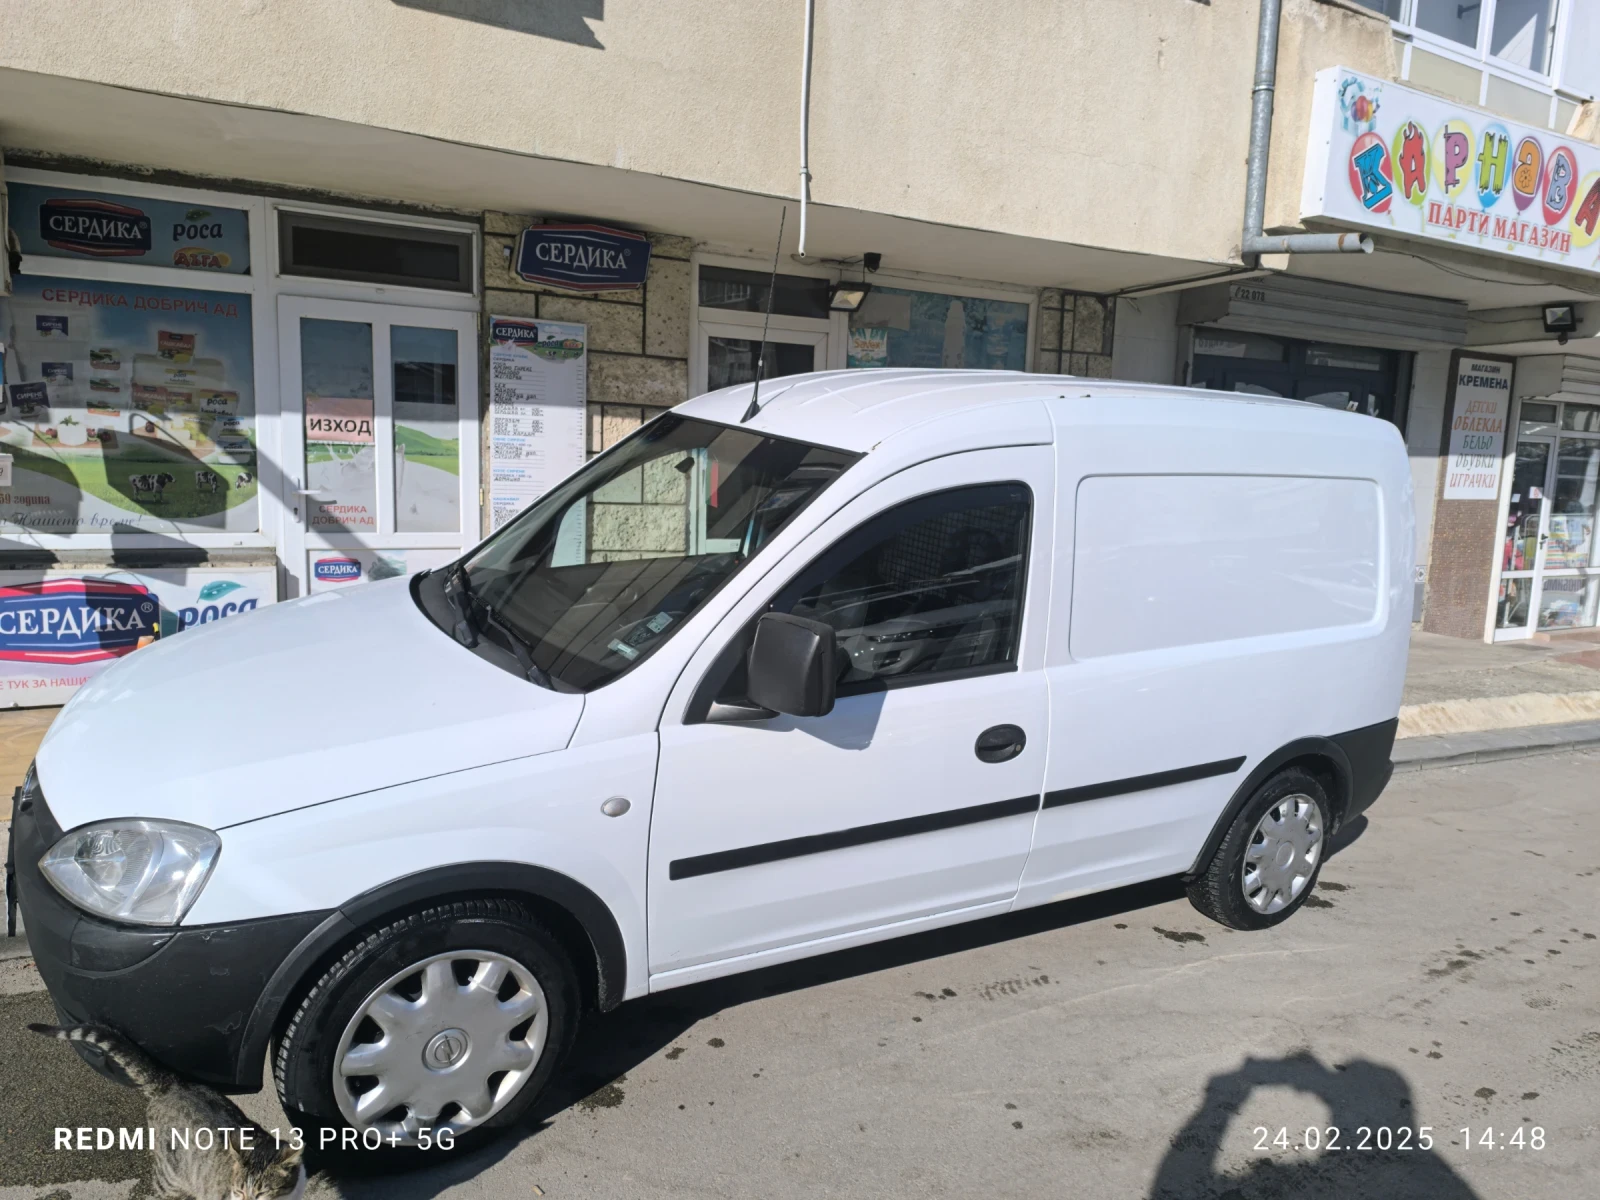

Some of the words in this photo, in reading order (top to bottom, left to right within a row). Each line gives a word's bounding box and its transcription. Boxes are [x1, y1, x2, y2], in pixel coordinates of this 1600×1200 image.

[1427, 202, 1489, 236] ПАРТИ
[1493, 217, 1572, 254] МАГАЗИН
[41, 287, 129, 308] СЕРДИКА
[134, 292, 209, 314] ДОБРИЧ
[213, 303, 239, 318] АД
[854, 338, 881, 350] Savex
[1471, 363, 1501, 374] МАГАЗИН
[1458, 374, 1509, 391] КРЕМЕНА
[1465, 400, 1498, 415] ДЕТСКИ
[309, 418, 372, 436] ИЗХОД
[1453, 415, 1503, 433] ОБЛЕКЛА
[1462, 434, 1493, 450] БЕЛЬО
[1455, 453, 1495, 471] ОБУВКИ
[1449, 473, 1497, 488] ИГРАЧКИ
[14, 495, 51, 506] година
[318, 505, 367, 514] СЕРДИКА
[312, 516, 357, 525] ДОБРИЧ
[359, 516, 375, 525] АД
[317, 564, 358, 575] СЕРДИКА
[7, 680, 29, 690] ТУК
[32, 679, 47, 689] ЗА
[50, 676, 91, 688] НАШИ
